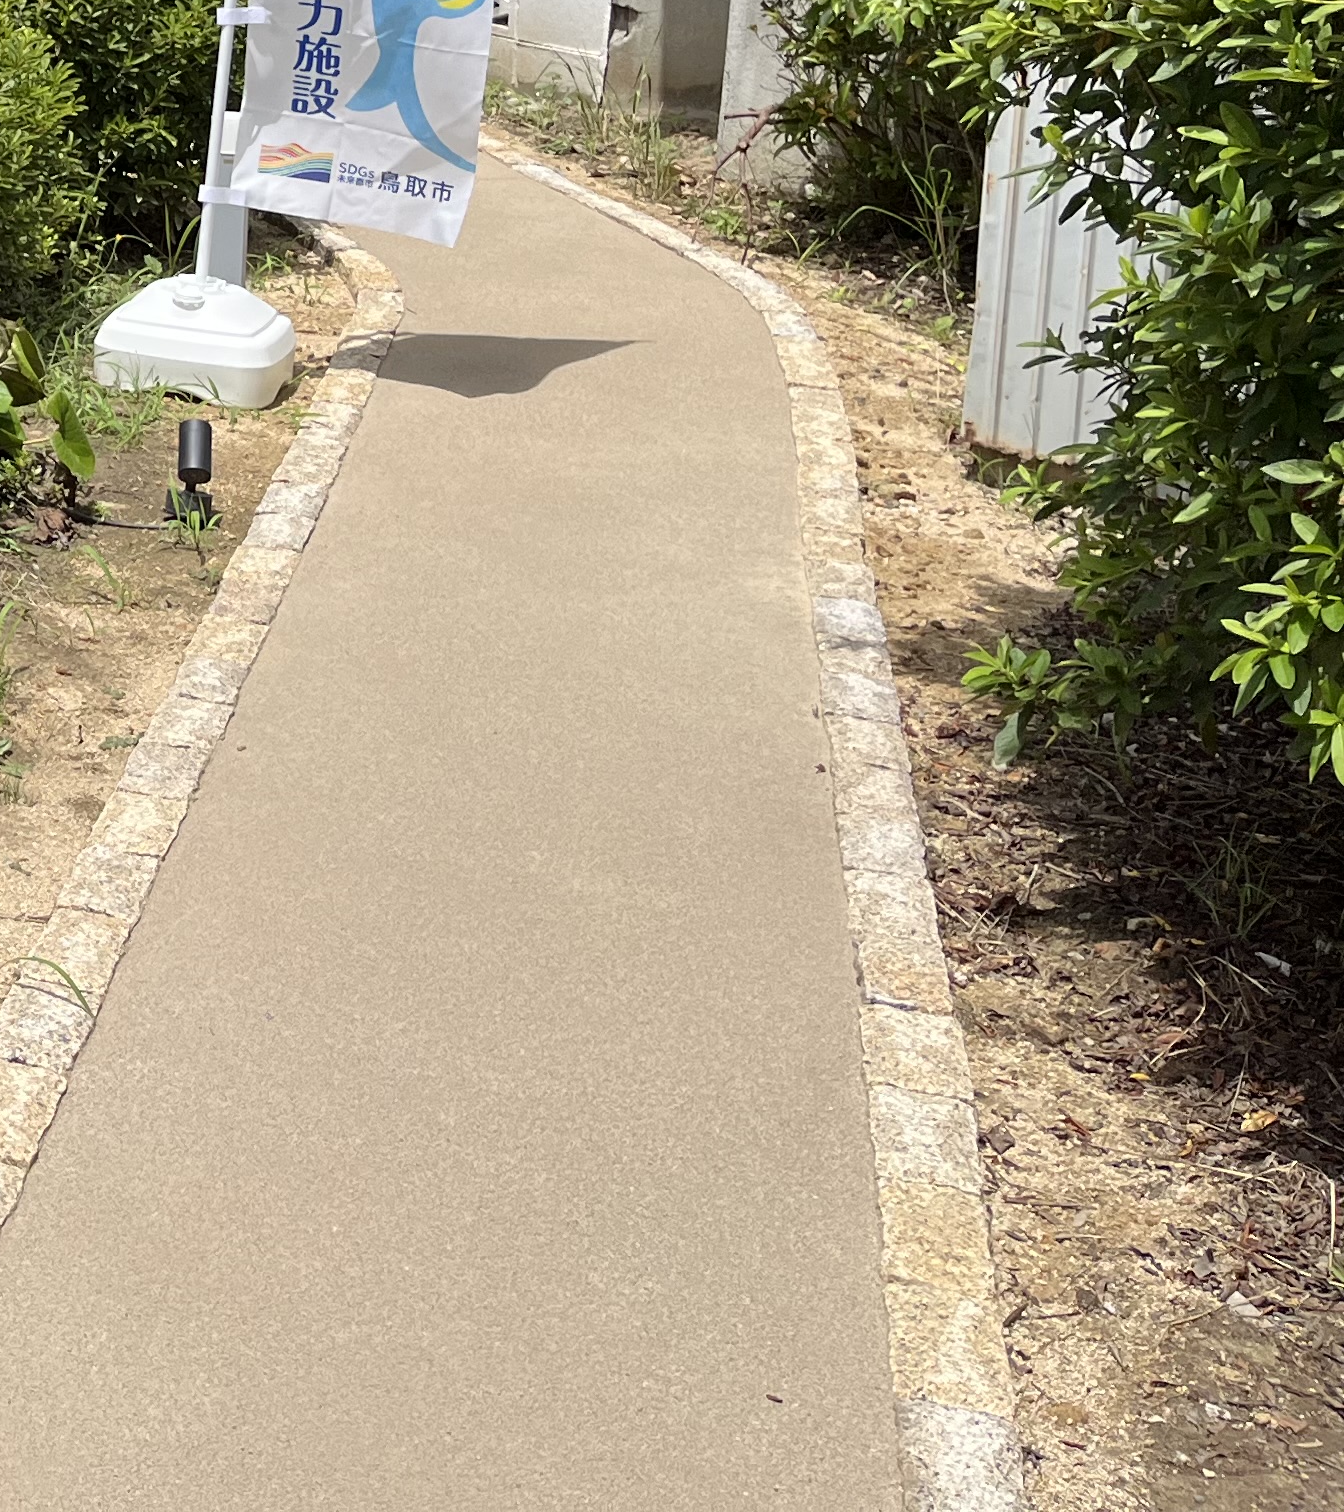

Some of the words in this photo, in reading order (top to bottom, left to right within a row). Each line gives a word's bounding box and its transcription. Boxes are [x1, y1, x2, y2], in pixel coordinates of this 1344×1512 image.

[338, 162, 375, 179] SDGs
[377, 170, 455, 203] 鳥取市
